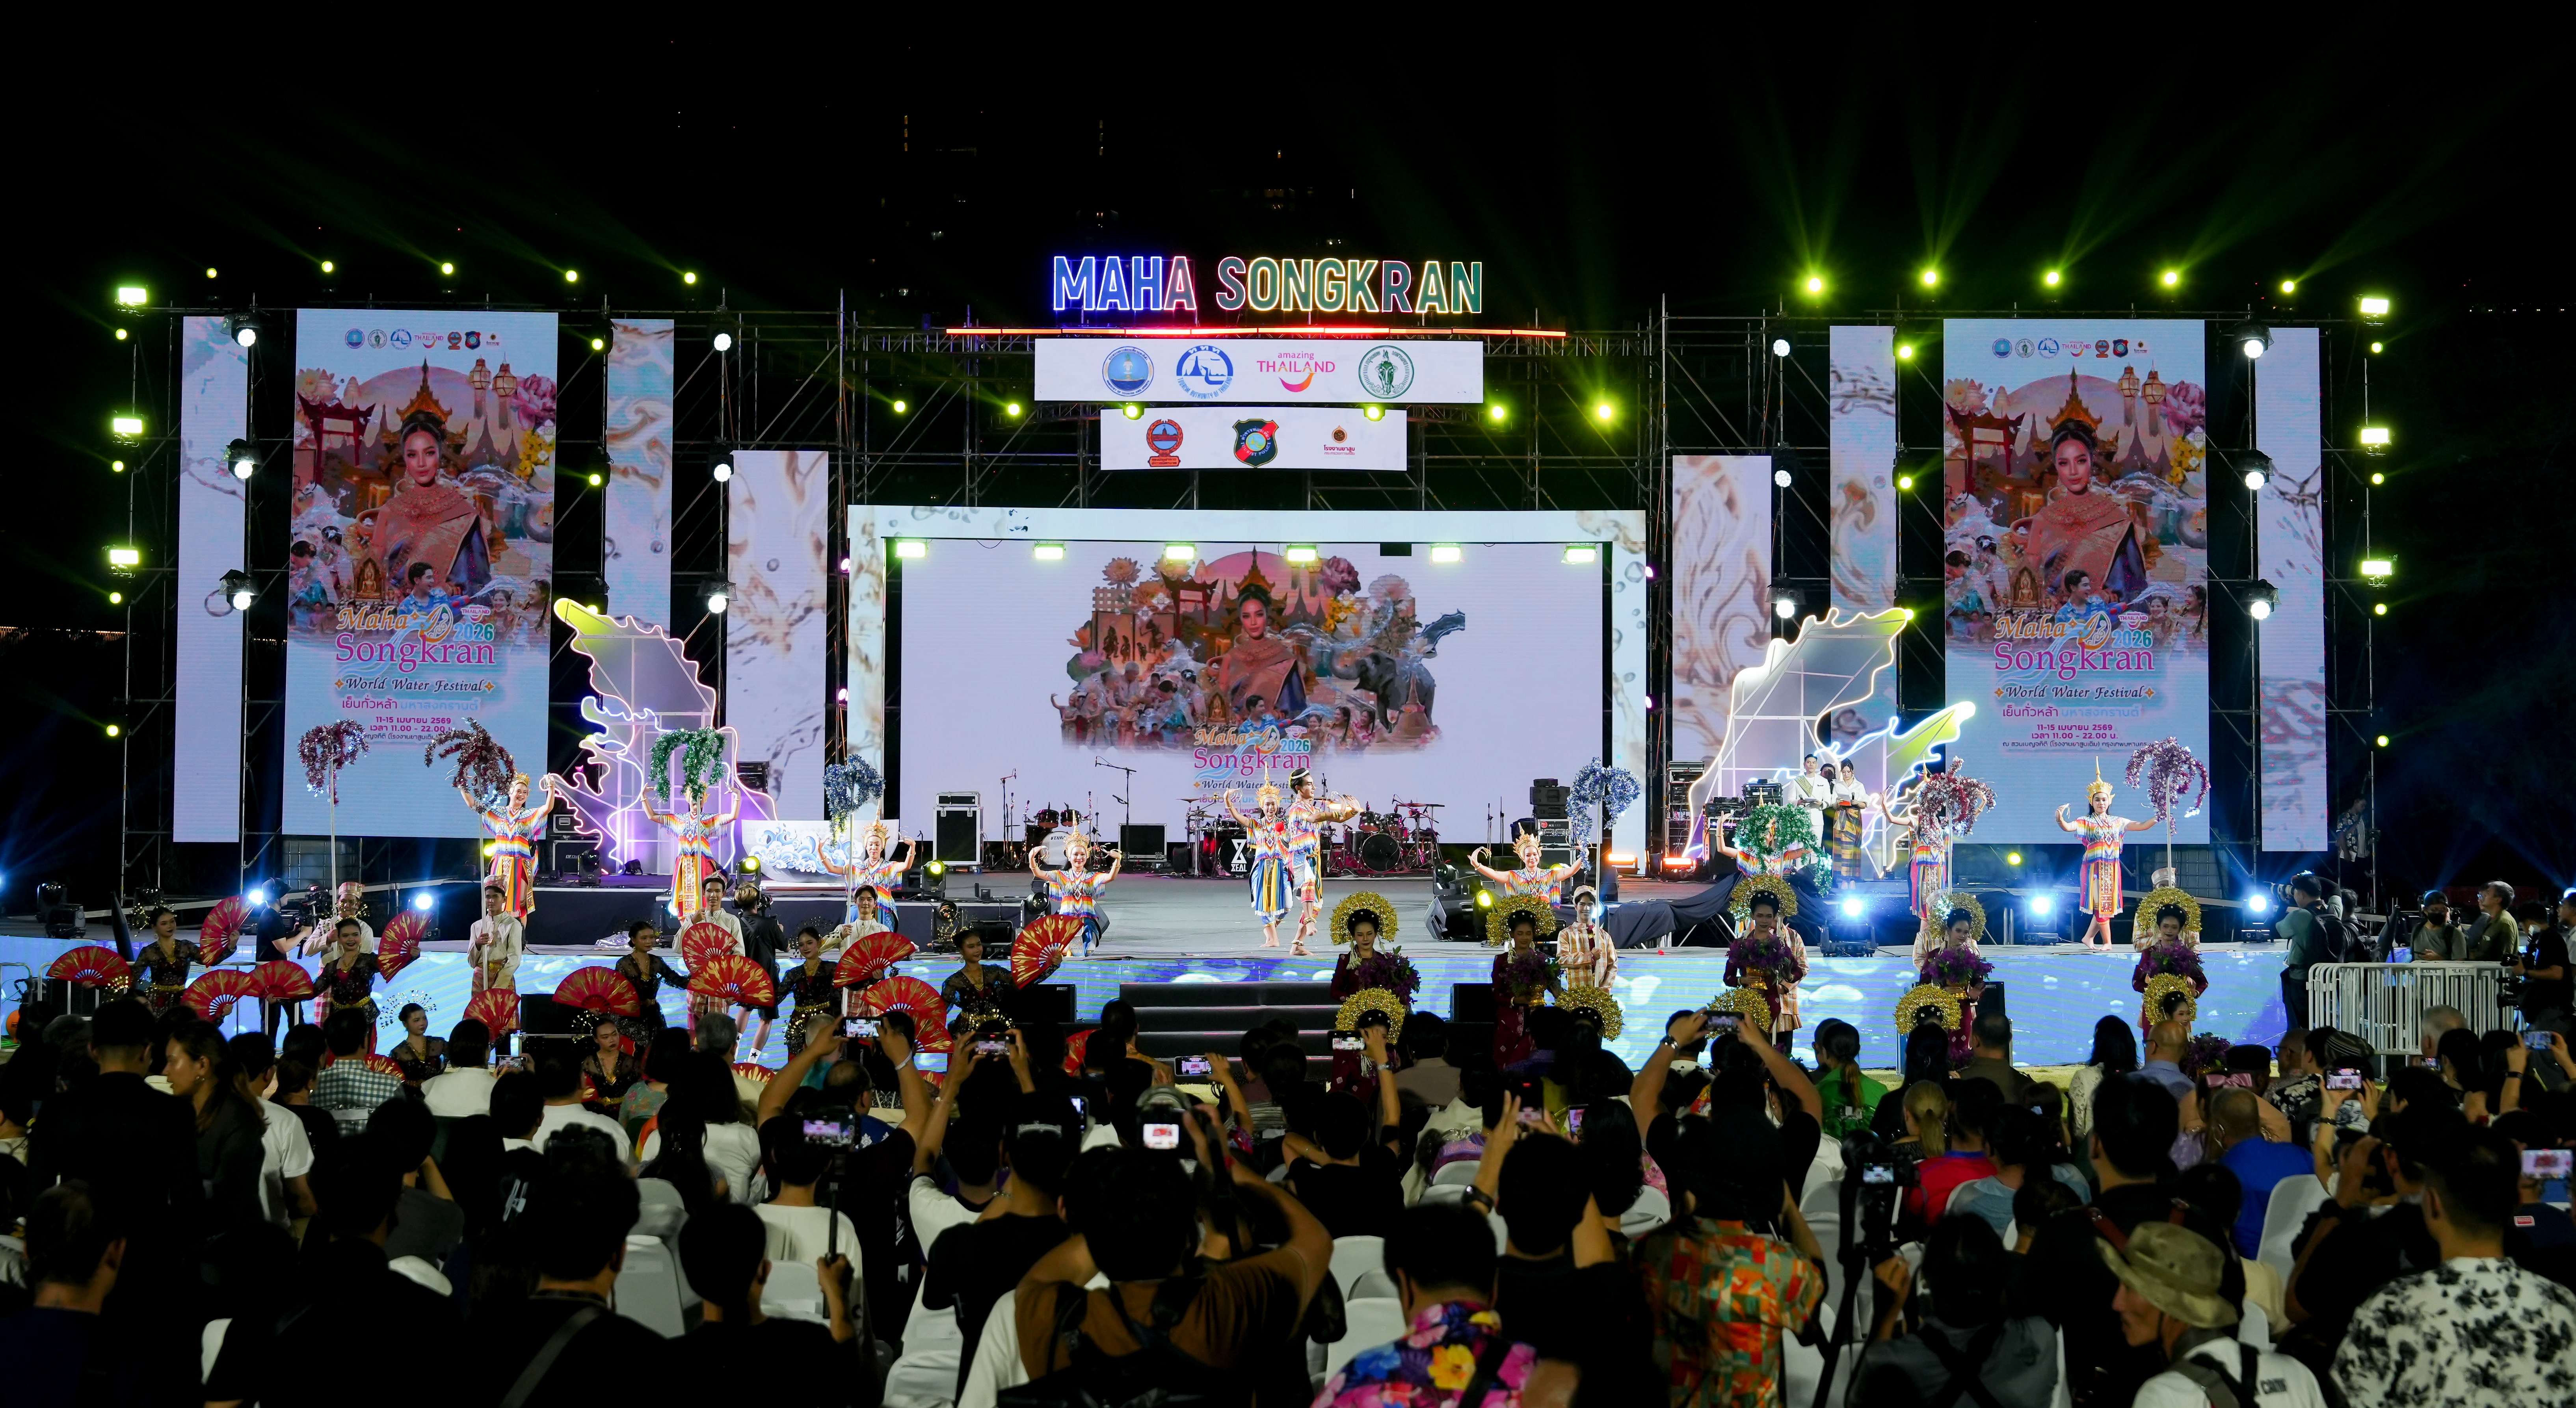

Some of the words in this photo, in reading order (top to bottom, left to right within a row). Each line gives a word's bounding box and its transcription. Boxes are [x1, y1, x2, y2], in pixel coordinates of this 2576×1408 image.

[1053, 256, 1196, 311] MAHA
[1216, 256, 1482, 314] SONGKRAN
[1278, 351, 1314, 360] amazing
[1257, 360, 1335, 373] THAILAND
[1241, 442, 1257, 456] TOURIST
[1258, 442, 1271, 456] POLICE
[337, 606, 408, 630] Maha
[1995, 614, 2066, 638] Maha
[454, 624, 493, 641] 2026
[2112, 630, 2153, 648] 2026
[336, 633, 495, 673] Songkran
[1994, 642, 2155, 680] Songkran
[346, 677, 388, 690] World
[392, 678, 430, 690] Water
[434, 679, 485, 692] Festival
[2006, 685, 2048, 698] World
[2052, 685, 2090, 698] Water
[2094, 685, 2144, 699] Festival
[342, 696, 397, 709] เย็นทั่วหล้า
[401, 700, 478, 711] มหาสงกรานต์
[2003, 703, 2058, 717] เย็นทั่วหล้า
[2061, 707, 2140, 717] มหาสงกรานต์
[1194, 728, 1247, 745] Maha
[1280, 739, 1310, 752] 2026
[1194, 747, 1311, 776] Songkran
[1202, 780, 1232, 789] World
[1236, 780, 1263, 789] Water
